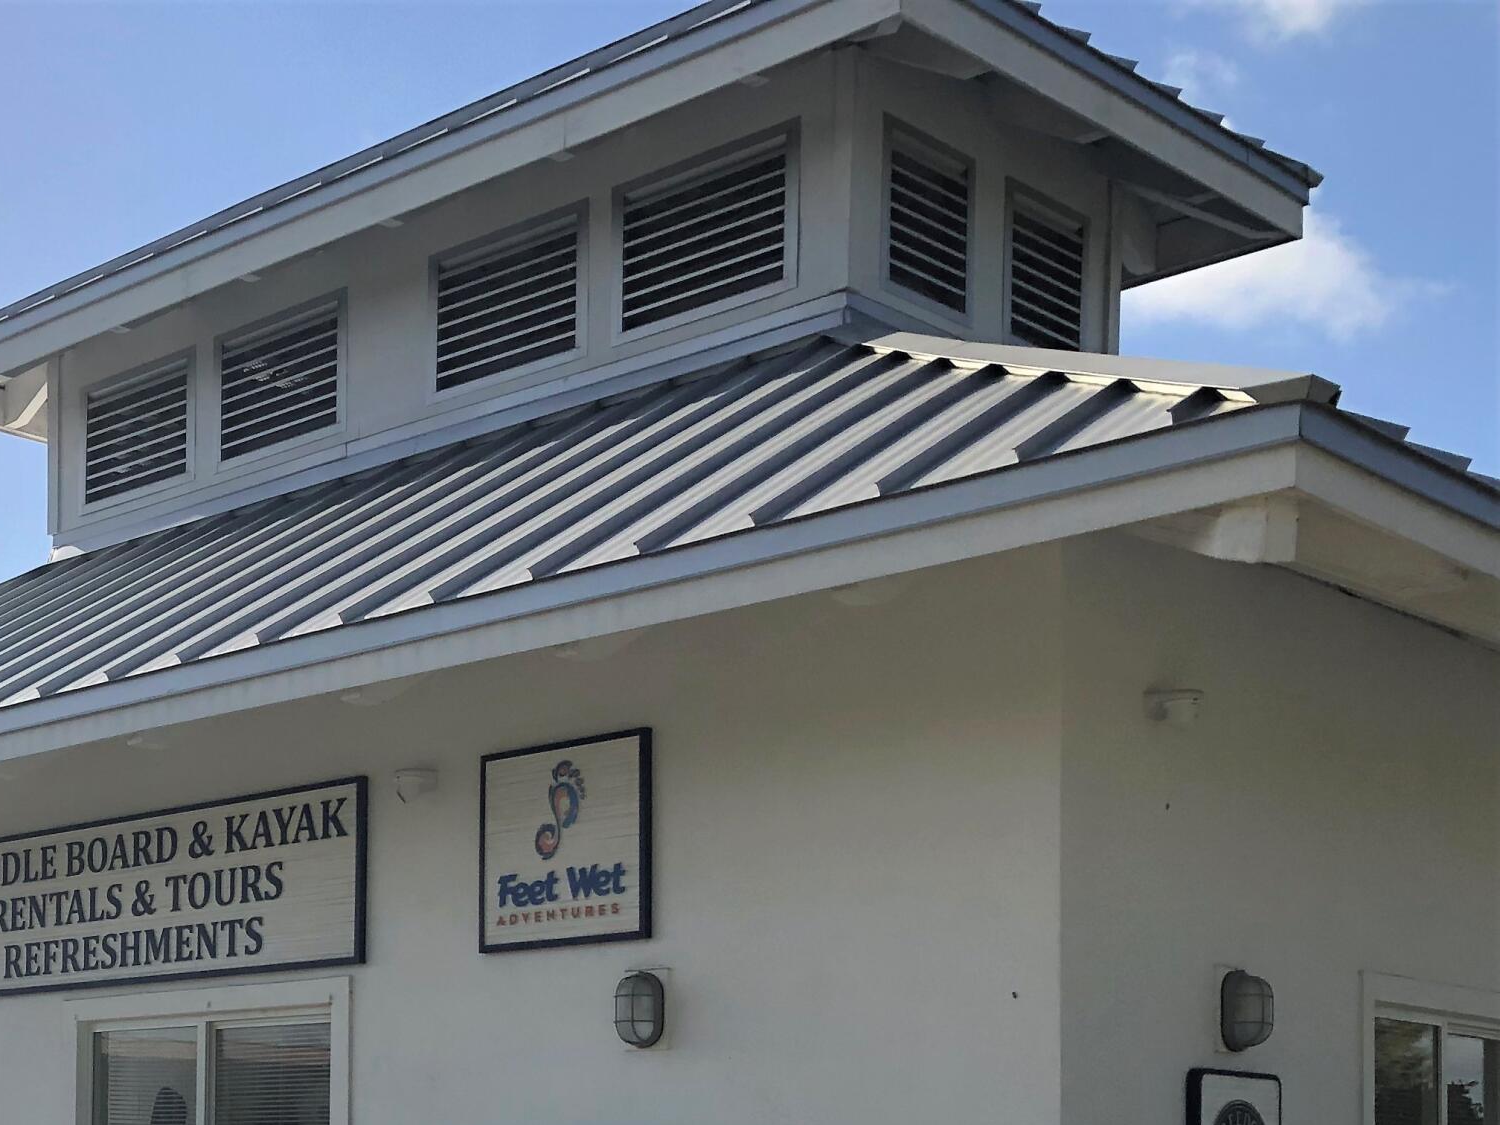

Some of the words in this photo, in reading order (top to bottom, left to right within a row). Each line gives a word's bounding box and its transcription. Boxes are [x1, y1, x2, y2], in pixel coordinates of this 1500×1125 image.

[66, 826, 178, 878] BOARD
[188, 820, 215, 858] &
[225, 797, 348, 854] KAYAK
[131, 879, 157, 916] &
[165, 861, 284, 912] TOURS
[497, 870, 560, 908] Feet
[566, 862, 626, 901] Wet
[496, 902, 621, 926] ADVENTURES
[3, 917, 264, 979] REFRESHMENTS
